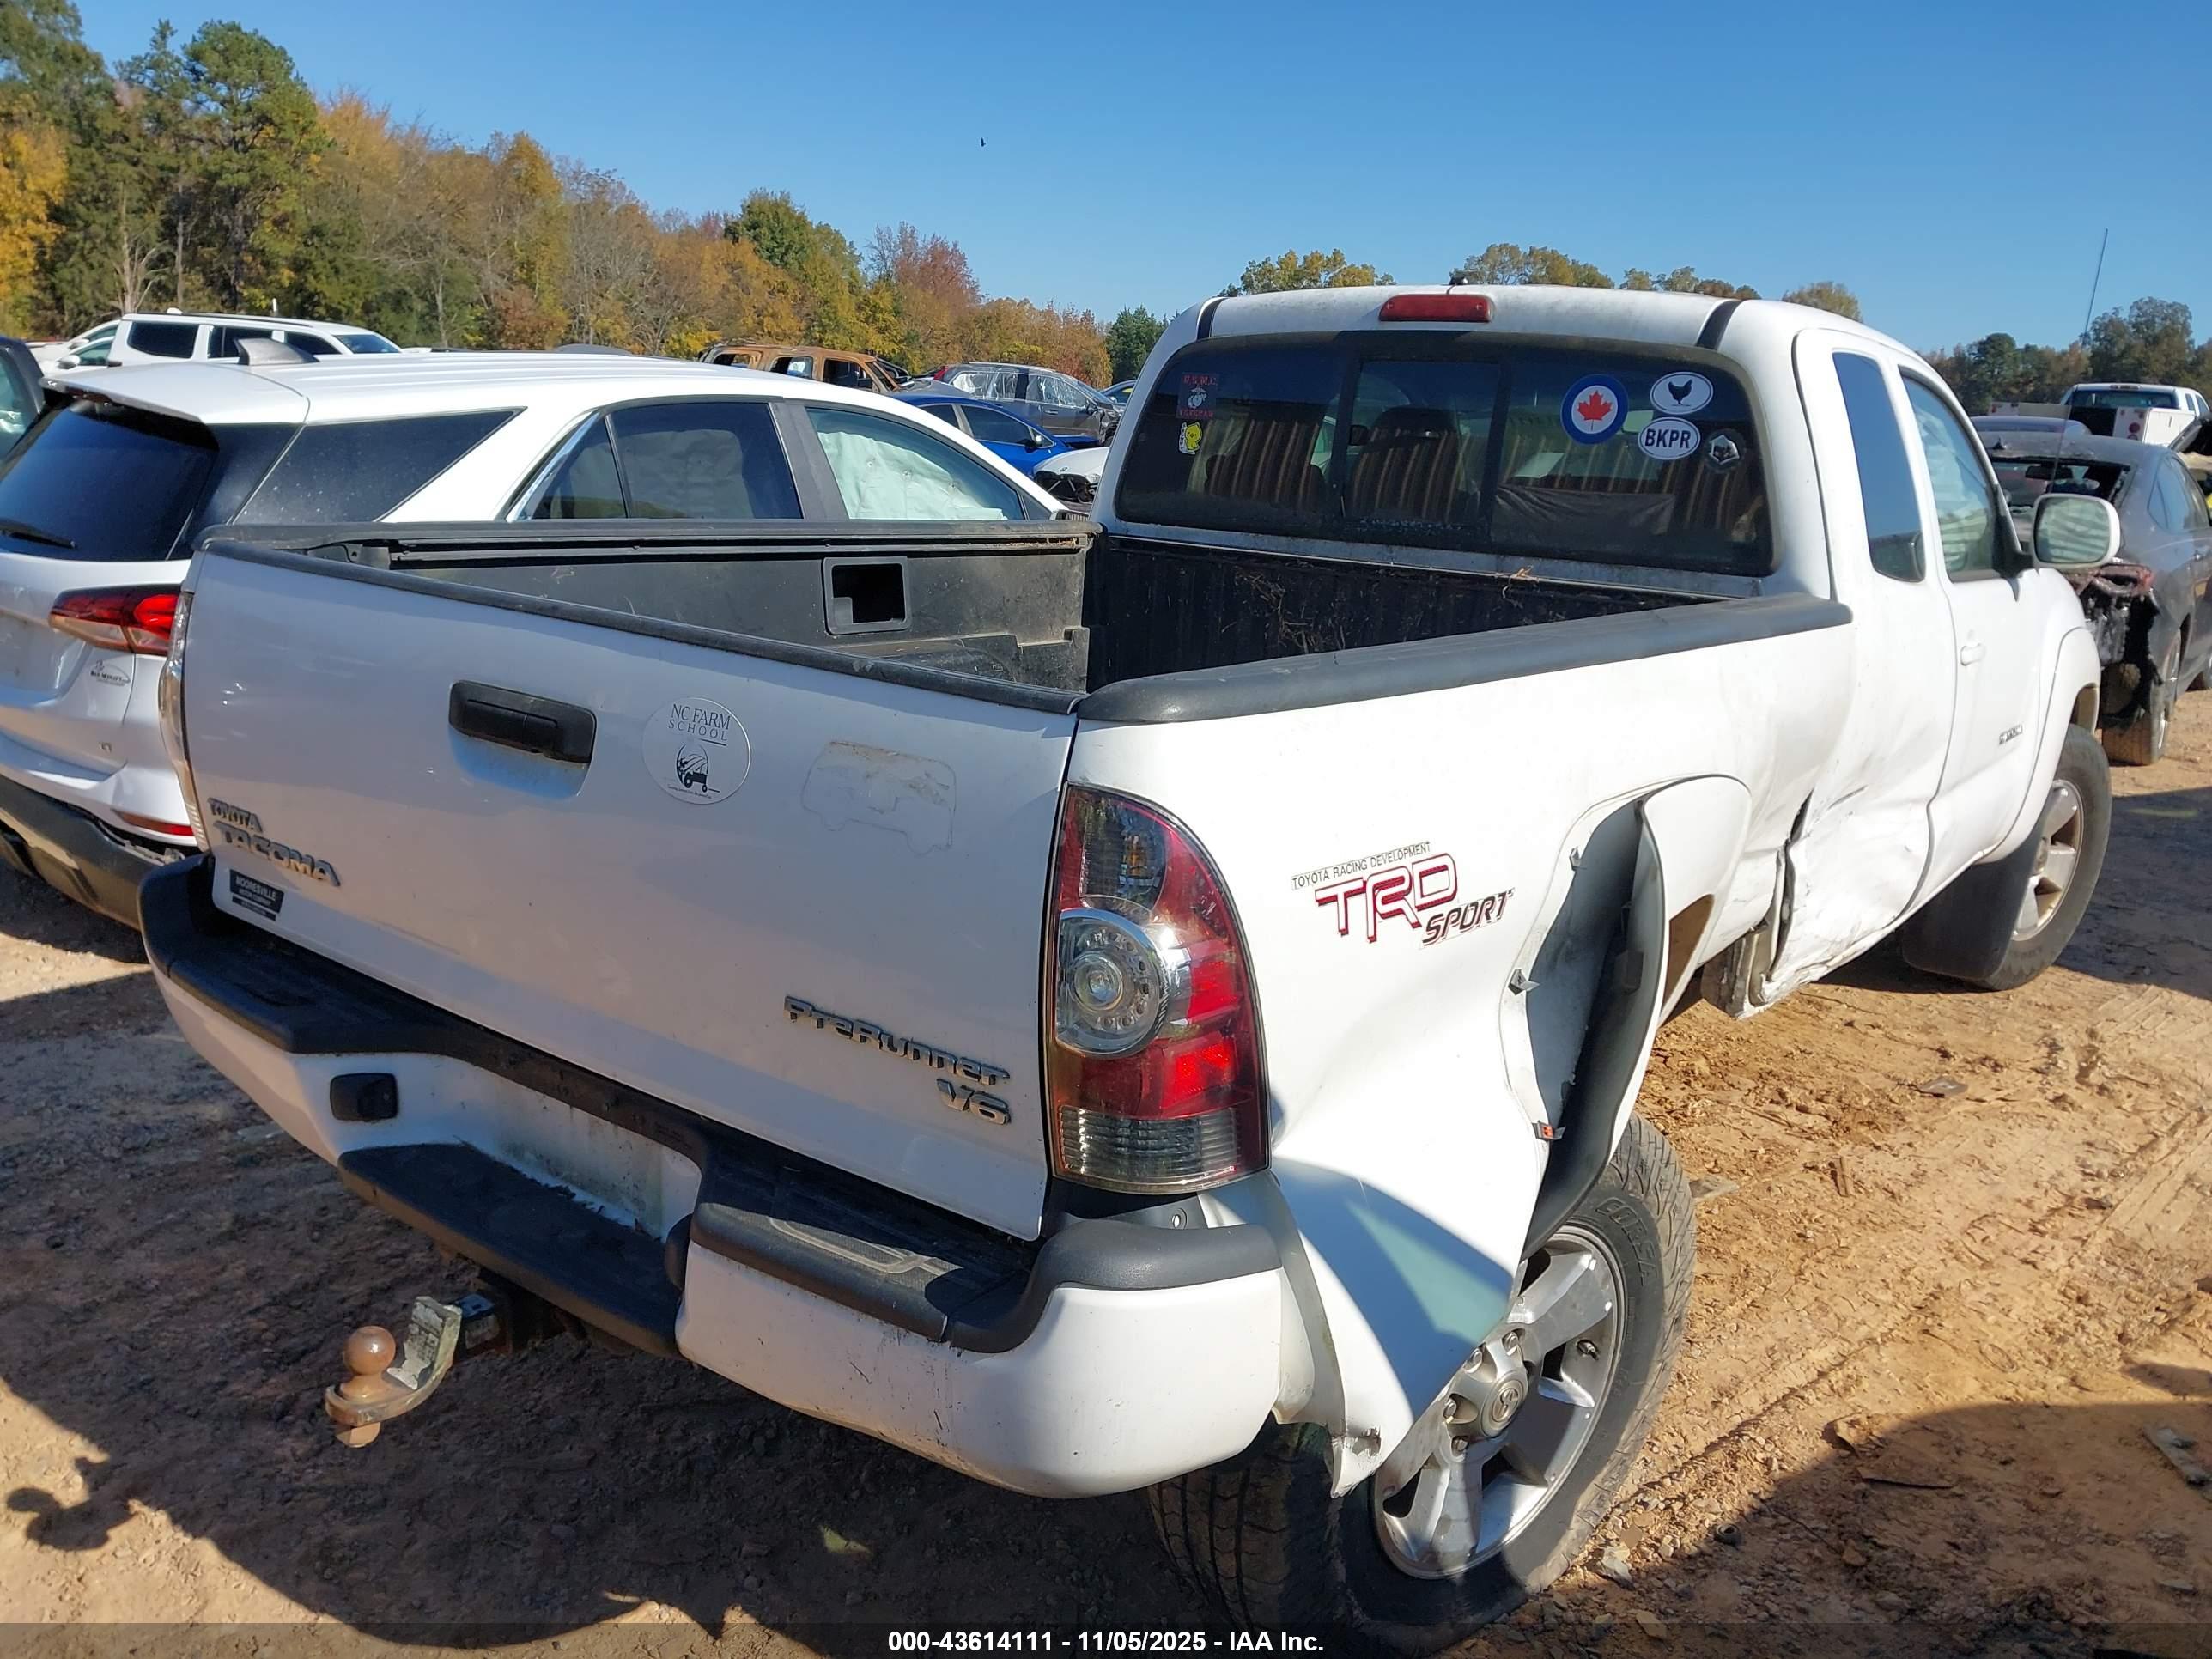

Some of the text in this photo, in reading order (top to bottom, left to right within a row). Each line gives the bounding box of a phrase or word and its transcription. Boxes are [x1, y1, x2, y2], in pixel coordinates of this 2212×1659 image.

[1644, 428, 1692, 449] BKPR
[668, 719, 728, 741] SCHOOL
[671, 704, 731, 730] NC FARM
[208, 797, 263, 833] TOYOTA
[214, 820, 341, 887] TACOMA
[1291, 842, 1431, 889] TOYOTA RACING DEVELOPMENT
[235, 875, 276, 902] MOORESVILLE
[1315, 853, 1458, 945] TRD
[1422, 891, 1510, 946] SPORT
[783, 995, 1011, 1086] PreRunner
[936, 1078, 1012, 1126] V6
[1595, 1196, 1658, 1287] CORSA
